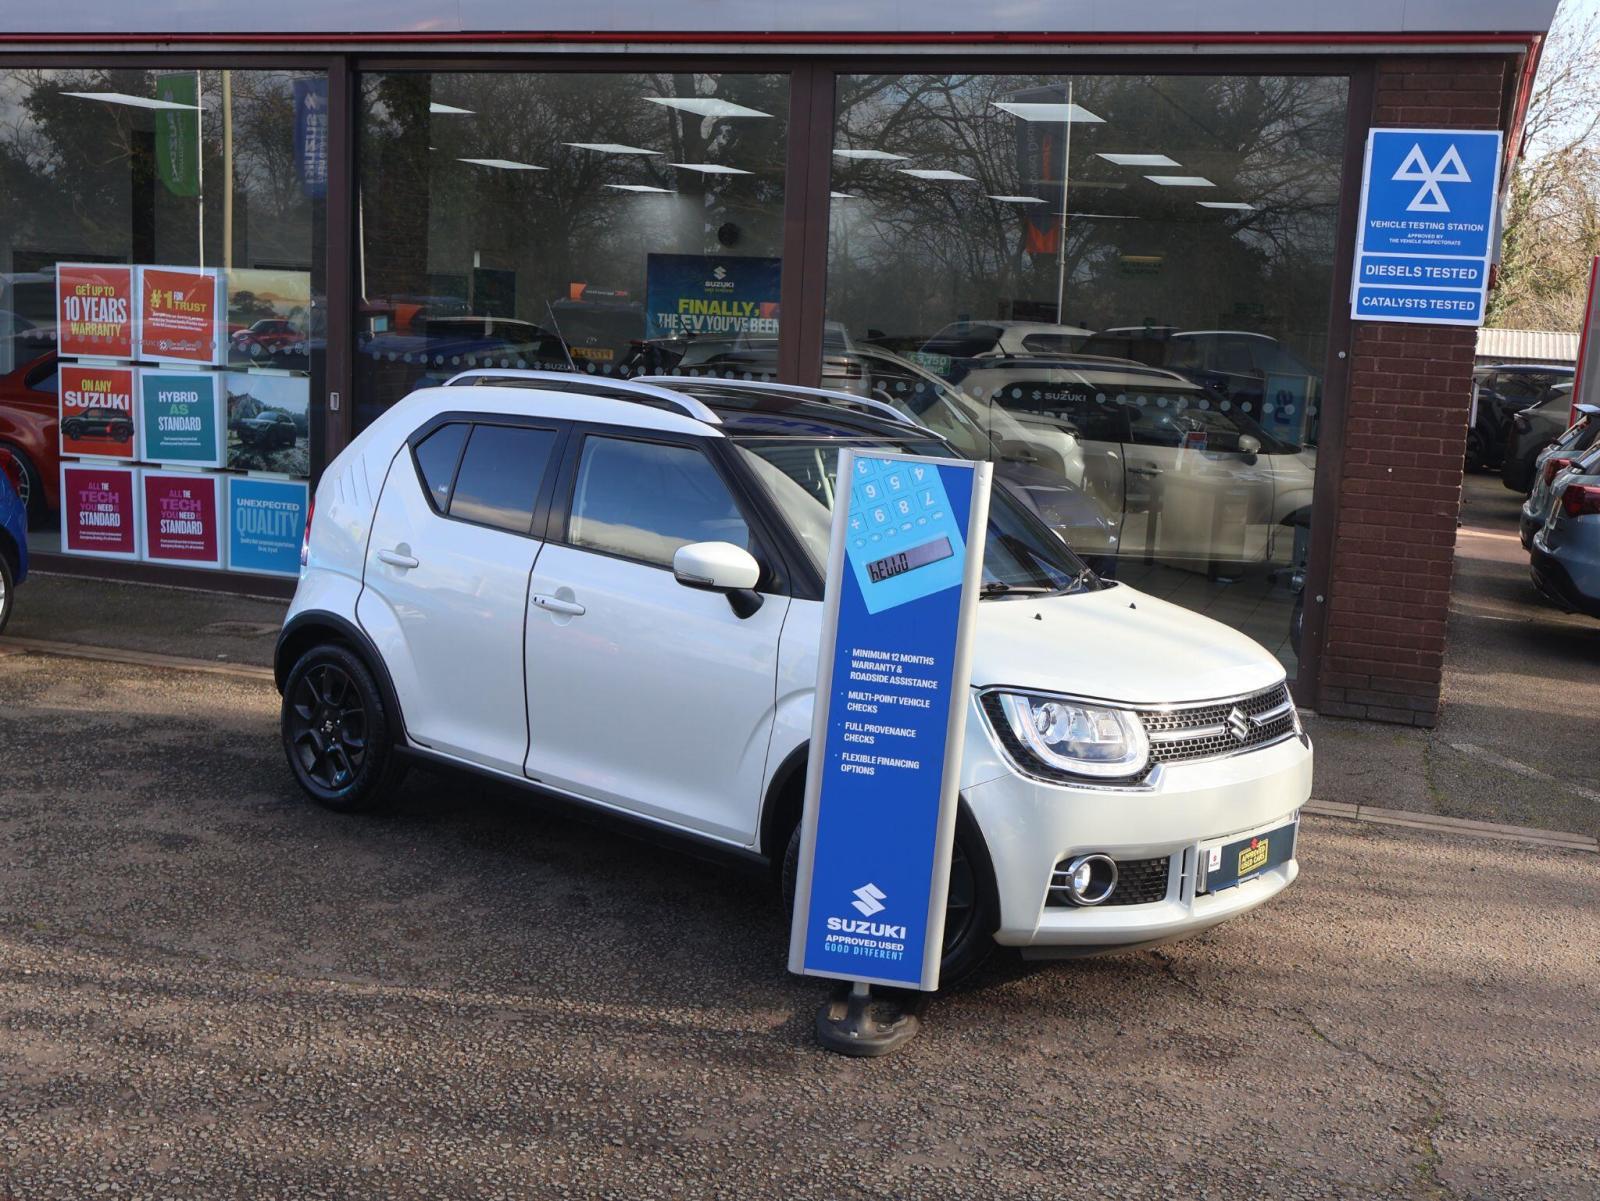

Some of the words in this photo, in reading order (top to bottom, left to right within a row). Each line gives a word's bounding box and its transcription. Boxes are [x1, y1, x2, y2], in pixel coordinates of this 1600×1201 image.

[1370, 220, 1406, 229] VEHICLE
[1408, 221, 1445, 231] TESTING
[1447, 222, 1484, 232] STATION
[1365, 264, 1422, 277] DIESELS
[1425, 266, 1478, 280] TESTED
[76, 284, 91, 296] GET
[92, 286, 103, 296] UP
[104, 286, 114, 297] TO
[704, 281, 735, 289] SUZUKI
[150, 289, 173, 308] #1
[1362, 296, 1427, 309] CATALYSTS
[1429, 299, 1475, 311] TESTED
[64, 296, 80, 321] 10
[81, 297, 127, 324] YEARS
[174, 301, 207, 313] TRUST
[678, 298, 760, 317] FINALLY,
[70, 322, 121, 337] WARRANTY
[657, 313, 678, 328] THE
[680, 314, 705, 330] EV
[706, 316, 748, 332] YOU'VE
[81, 379, 94, 391] ON
[95, 380, 112, 392] ANY
[64, 391, 130, 410] SUZUKI
[158, 391, 199, 403] HYBRID
[1044, 391, 1087, 402] SUZUKI
[169, 404, 189, 415] AS
[158, 416, 201, 431] STANDARD
[88, 482, 100, 490] ALL
[80, 491, 119, 503] TECH
[169, 490, 182, 498] ALL
[183, 490, 191, 498] THE
[80, 503, 97, 511] YOU
[97, 504, 114, 512] NEED
[160, 498, 201, 511] TECH
[237, 498, 300, 511] UNEXPECTED
[80, 511, 120, 527] STANDARD
[161, 511, 178, 519] YOU
[179, 512, 195, 520] NEED
[236, 507, 299, 537] QUALITY
[160, 519, 203, 535] STANDARD
[852, 648, 890, 660] MINIMUM
[891, 652, 900, 662] 12
[900, 654, 935, 666] MONTHS
[851, 659, 896, 673] WARRANTY
[896, 665, 903, 673] &
[850, 671, 889, 684] ROADSIDE
[890, 676, 938, 689] ASSISTANCE
[848, 691, 898, 704] MULTI-POINT
[898, 696, 931, 709] VEHICLE
[847, 702, 878, 714] CHECKS
[845, 721, 863, 732] FULL
[864, 724, 917, 738] PROVENANCE
[844, 733, 875, 745] CHECKS
[842, 752, 877, 764] FLEXIBLE
[877, 757, 920, 769] FINANCING
[840, 764, 875, 776] OPTIONS
[826, 916, 907, 940] SUZUKI
[826, 934, 877, 948] APPROVED
[878, 941, 904, 951] USED
[824, 942, 849, 954] GOOD
[853, 946, 904, 961] DIFFERENT
